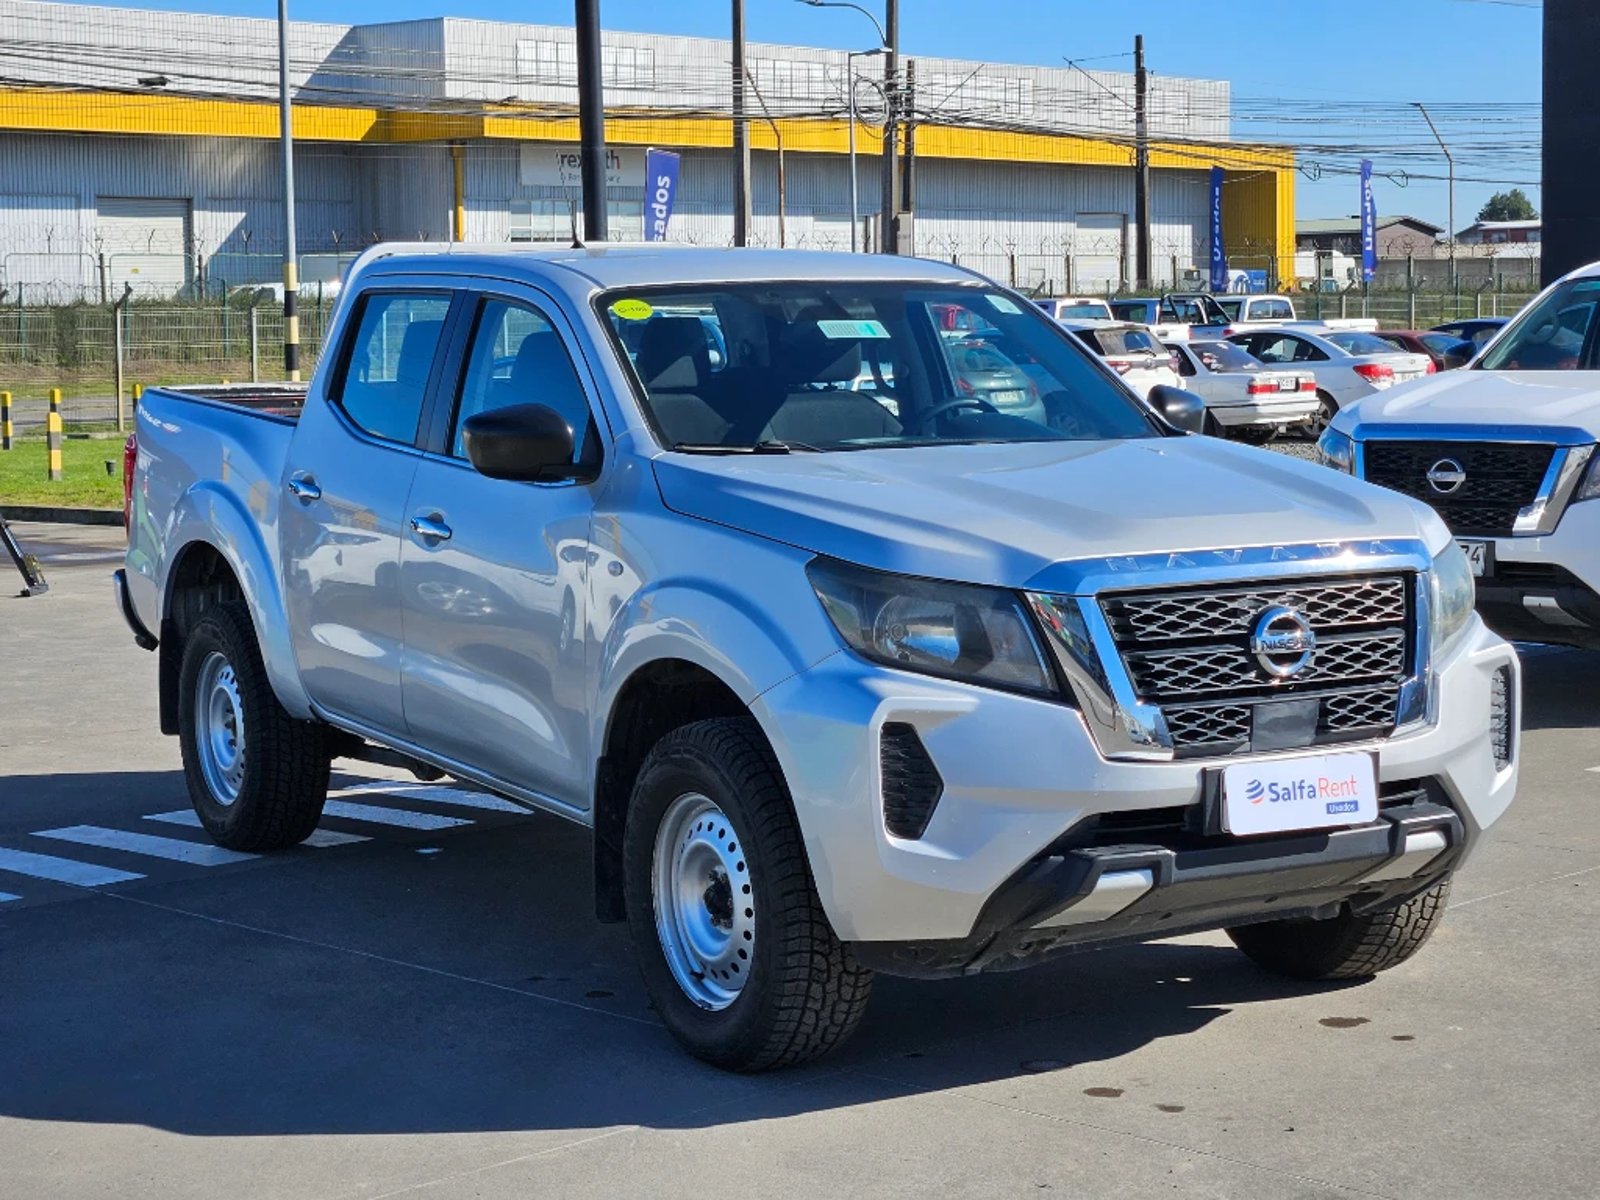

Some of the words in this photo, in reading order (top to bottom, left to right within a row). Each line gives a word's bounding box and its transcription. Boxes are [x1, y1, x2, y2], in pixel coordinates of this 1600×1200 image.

[652, 176, 671, 242] sados
[1261, 637, 1314, 651] NISSAN
[1268, 775, 1358, 802] SalfaRent
[1329, 803, 1355, 813] Usados
